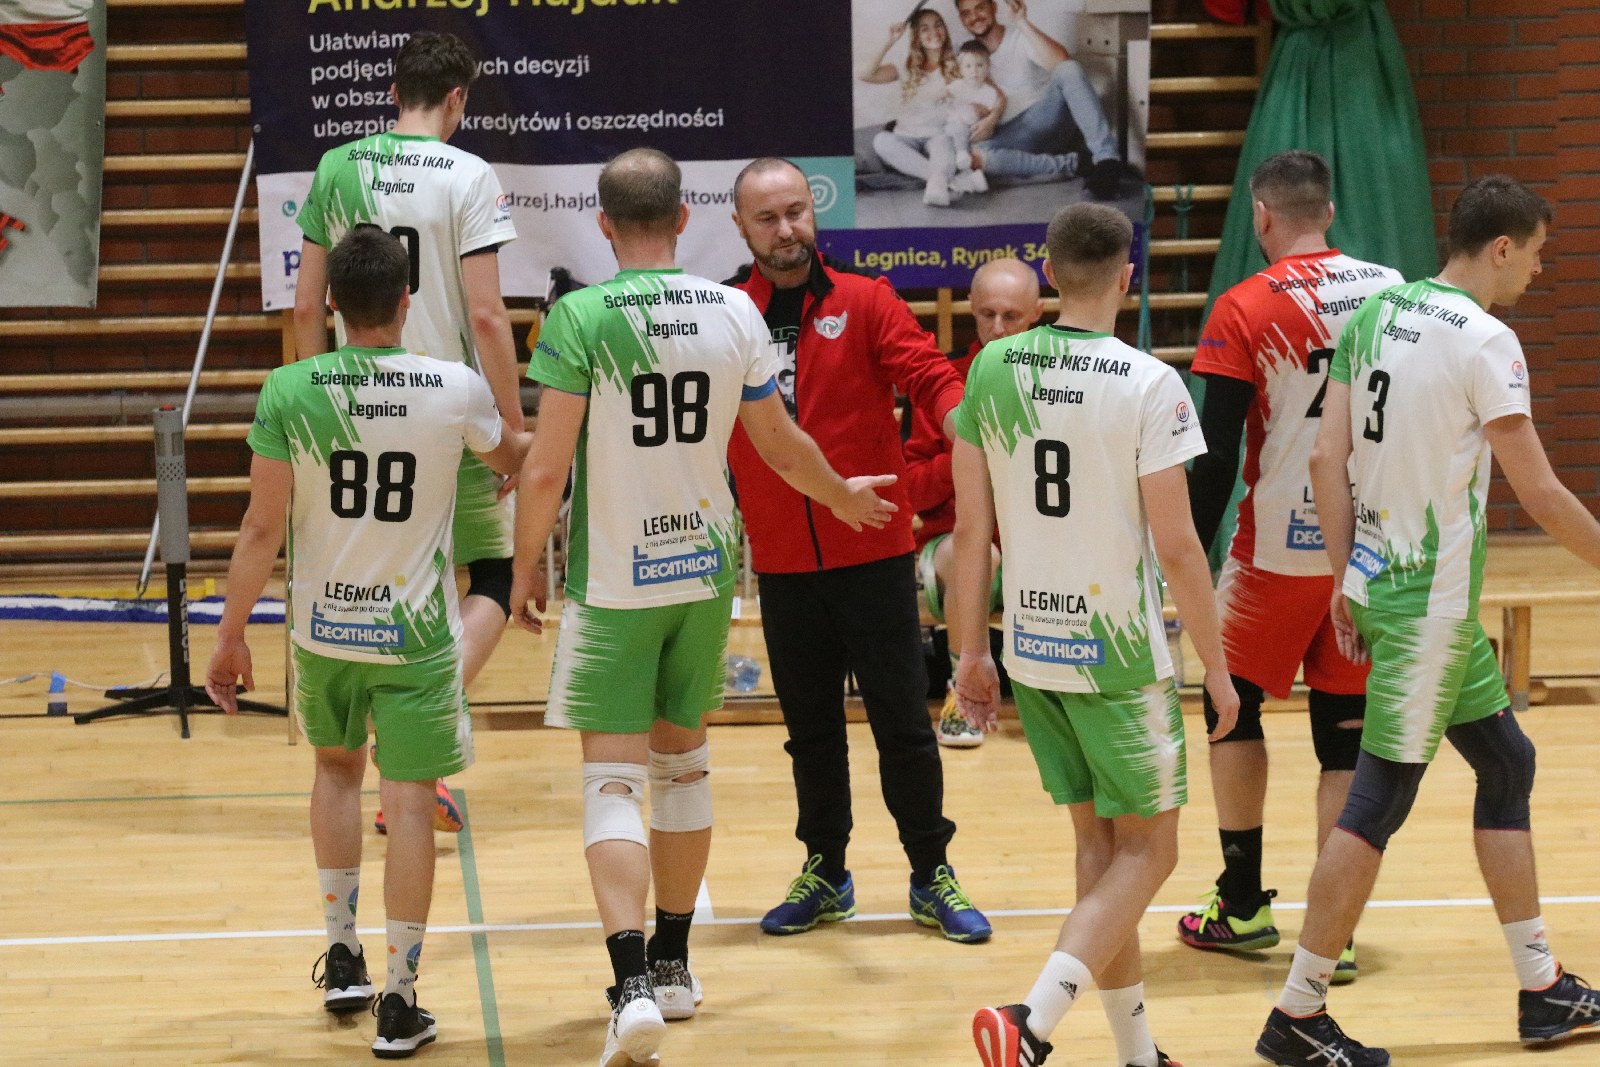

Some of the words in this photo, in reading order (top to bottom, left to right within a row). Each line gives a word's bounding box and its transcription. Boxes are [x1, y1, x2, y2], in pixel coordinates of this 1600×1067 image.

[309, 30, 410, 53] Ułatwiam
[311, 58, 397, 85] podjęci
[514, 55, 590, 77] decyzji
[312, 95, 330, 109] w
[335, 89, 393, 108] obsza
[313, 115, 397, 138] ubezpie
[460, 111, 560, 135] kredytów
[566, 112, 571, 130] i
[576, 107, 724, 132] oszczędności
[348, 148, 393, 166] Science
[395, 154, 421, 166] MKS
[422, 156, 454, 170] IKAR
[372, 177, 415, 195] Legnica
[855, 246, 947, 271] Legnica,
[1268, 277, 1325, 293] Science
[1326, 269, 1356, 285] MKS
[1357, 267, 1386, 280] IKAR
[604, 289, 661, 309] Science
[664, 289, 693, 305] MKS
[695, 289, 726, 305] IKAR
[1379, 290, 1416, 312] Science
[1414, 301, 1439, 315] MKS
[1434, 308, 1468, 329] IKAR
[646, 320, 698, 339] Legnica
[1383, 320, 1421, 343] Legnica
[1003, 348, 1056, 369] Science
[1060, 355, 1089, 372] MKS
[1093, 358, 1131, 377] IKAR
[311, 371, 369, 387] Science
[374, 372, 405, 387] MKS
[410, 373, 443, 388] IKAR
[1032, 383, 1084, 405] Legnica
[1363, 369, 1390, 443] 3
[348, 401, 407, 419] Legnica
[631, 371, 710, 447] 98
[330, 450, 416, 522] 88
[1034, 439, 1071, 518] 8
[644, 511, 704, 537] LEGNICA
[638, 554, 717, 580] DECATHLON
[325, 581, 391, 603] LEGNICA
[1020, 589, 1087, 614] LEGNICA
[315, 622, 398, 643] DECATHLON
[1018, 636, 1097, 659] DECATHLON
